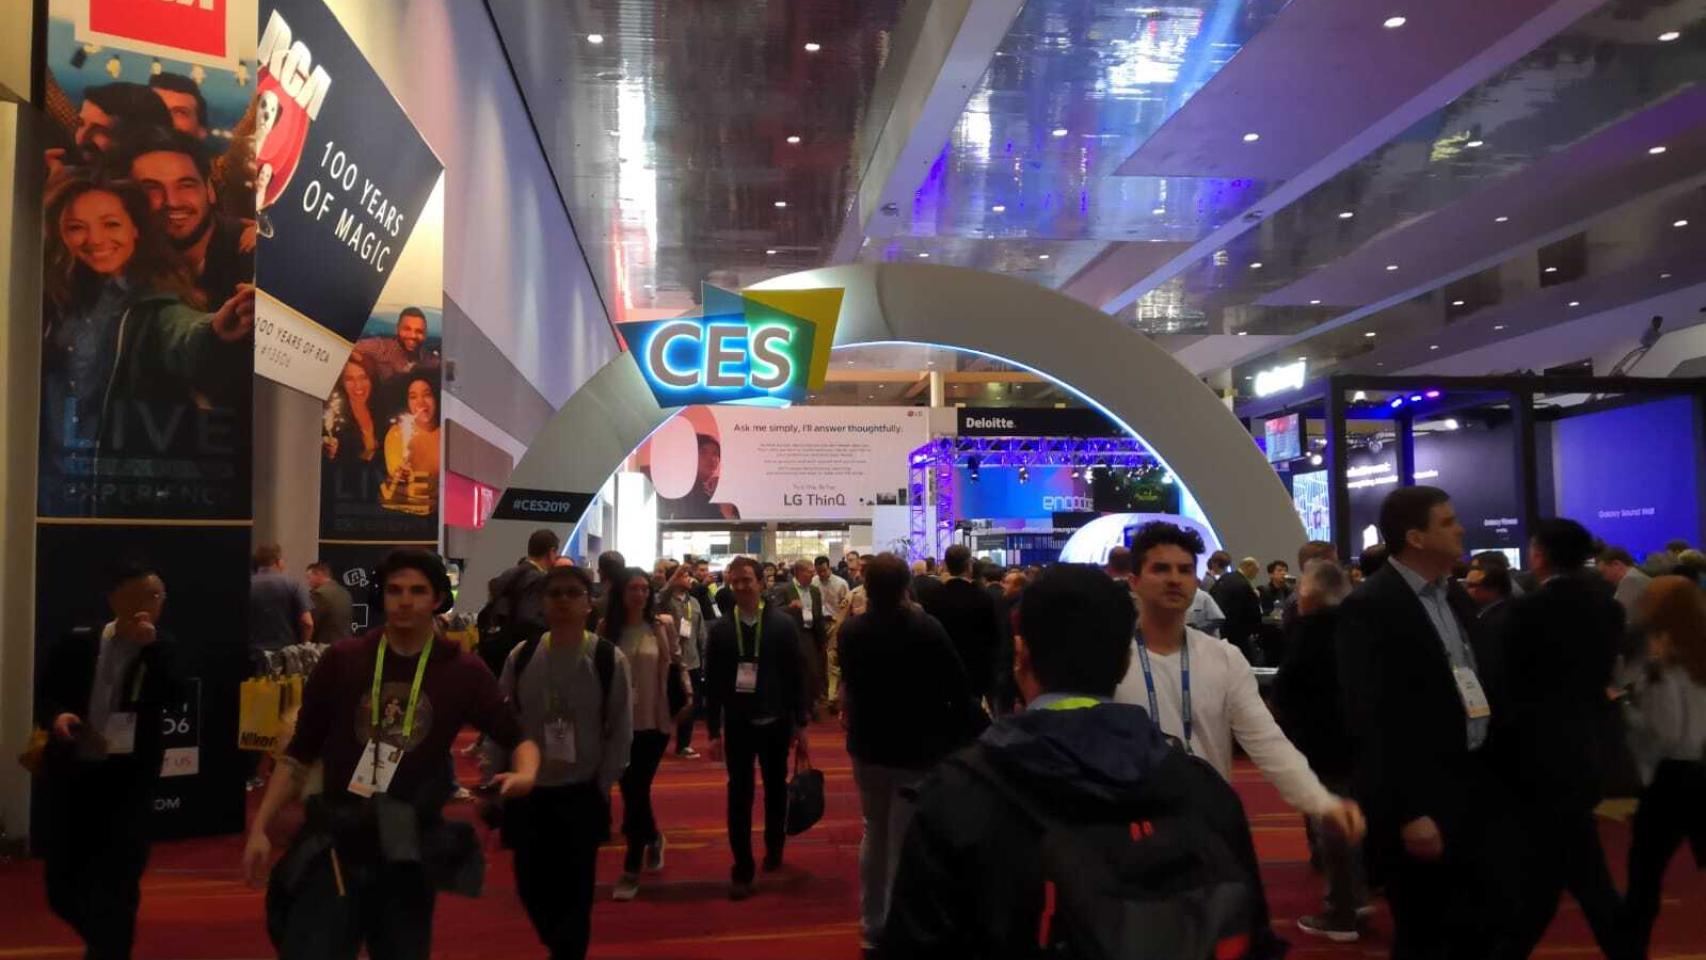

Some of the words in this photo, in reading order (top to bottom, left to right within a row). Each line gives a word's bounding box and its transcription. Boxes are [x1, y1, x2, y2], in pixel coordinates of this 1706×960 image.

[321, 141, 357, 191] 100
[360, 178, 404, 237] YEARS
[302, 180, 335, 221] OF
[334, 207, 391, 273] MAGIC
[649, 321, 793, 391] CES
[64, 396, 236, 455] LIVE
[733, 424, 750, 433] Ask
[753, 425, 767, 433] me
[769, 423, 801, 435] simply,
[813, 425, 846, 433] answer
[512, 499, 571, 514] #CES2019
[783, 494, 803, 507] LG
[806, 493, 847, 507] ThinQ
